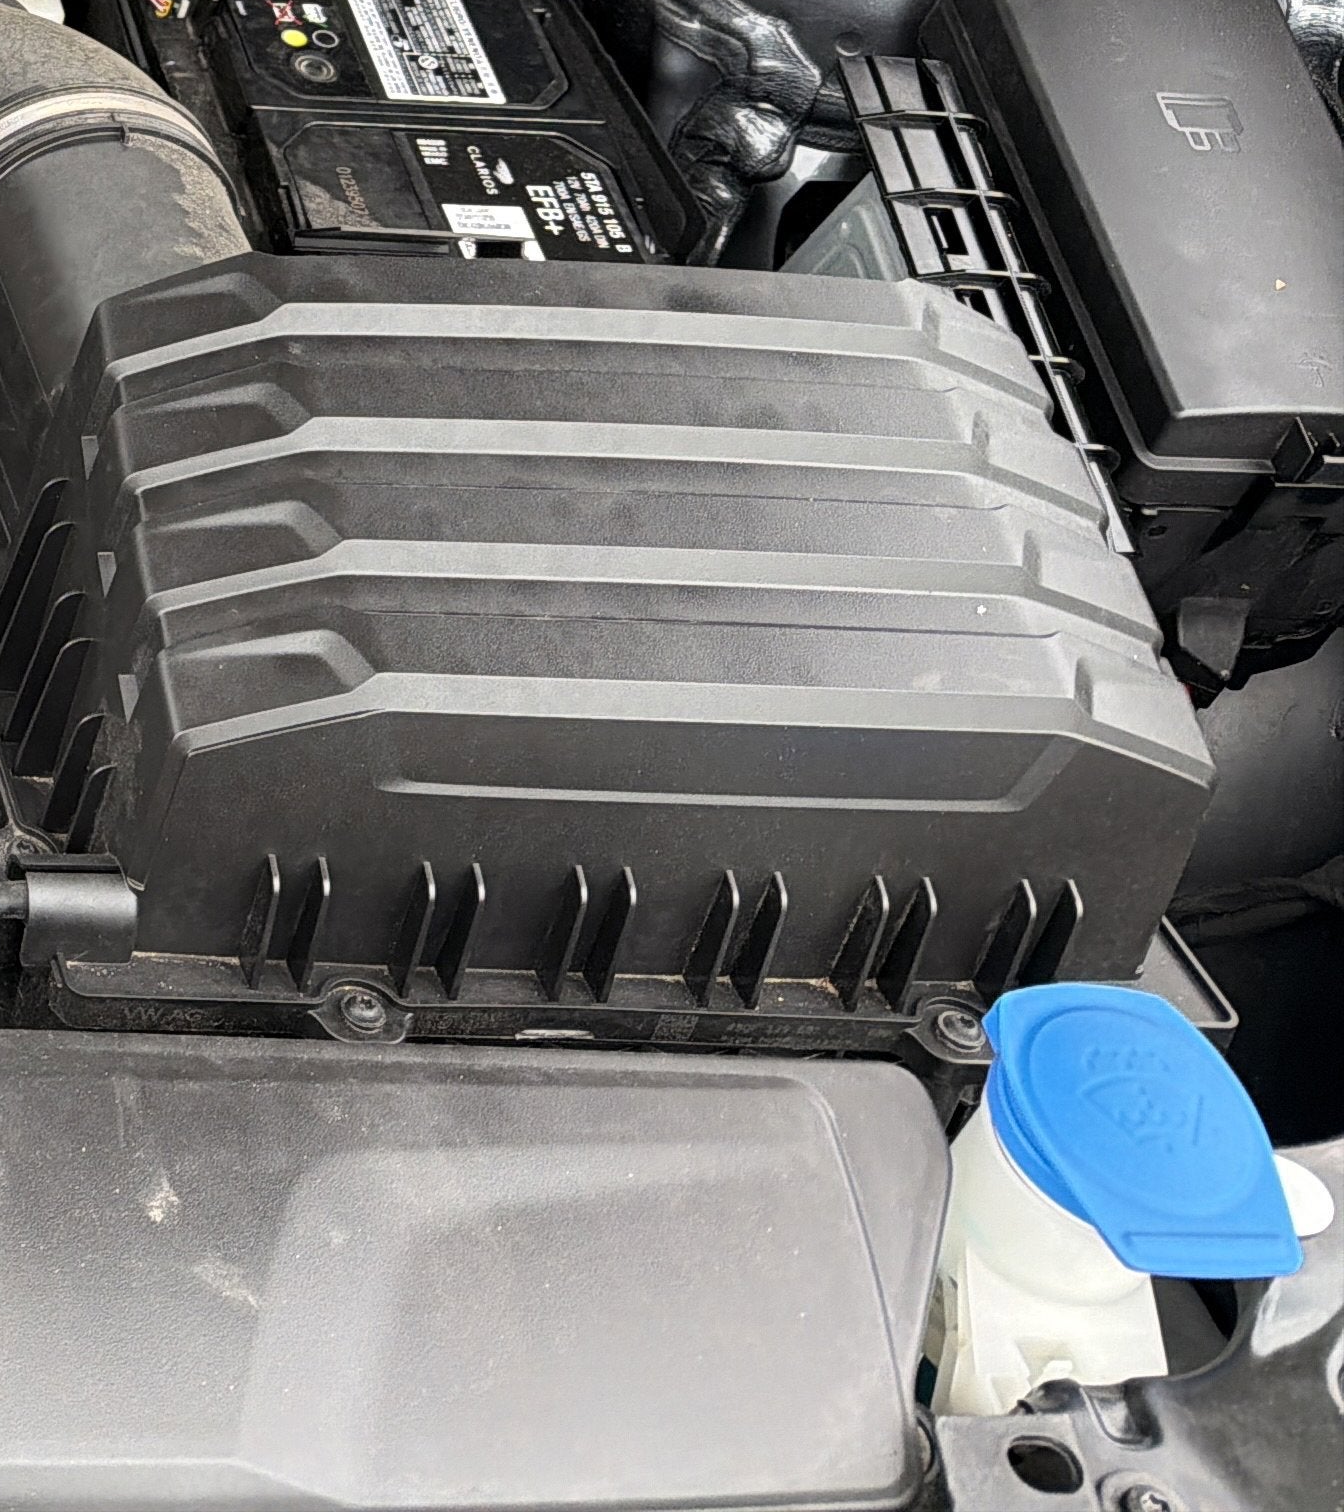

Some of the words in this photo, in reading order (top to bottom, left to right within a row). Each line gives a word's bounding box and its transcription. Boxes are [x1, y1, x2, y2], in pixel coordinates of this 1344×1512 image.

[467, 145, 499, 196] CLARIOS
[525, 184, 565, 236] EFB+
[591, 194, 614, 216] 915
[603, 219, 626, 239] 105
[615, 244, 632, 253] B
